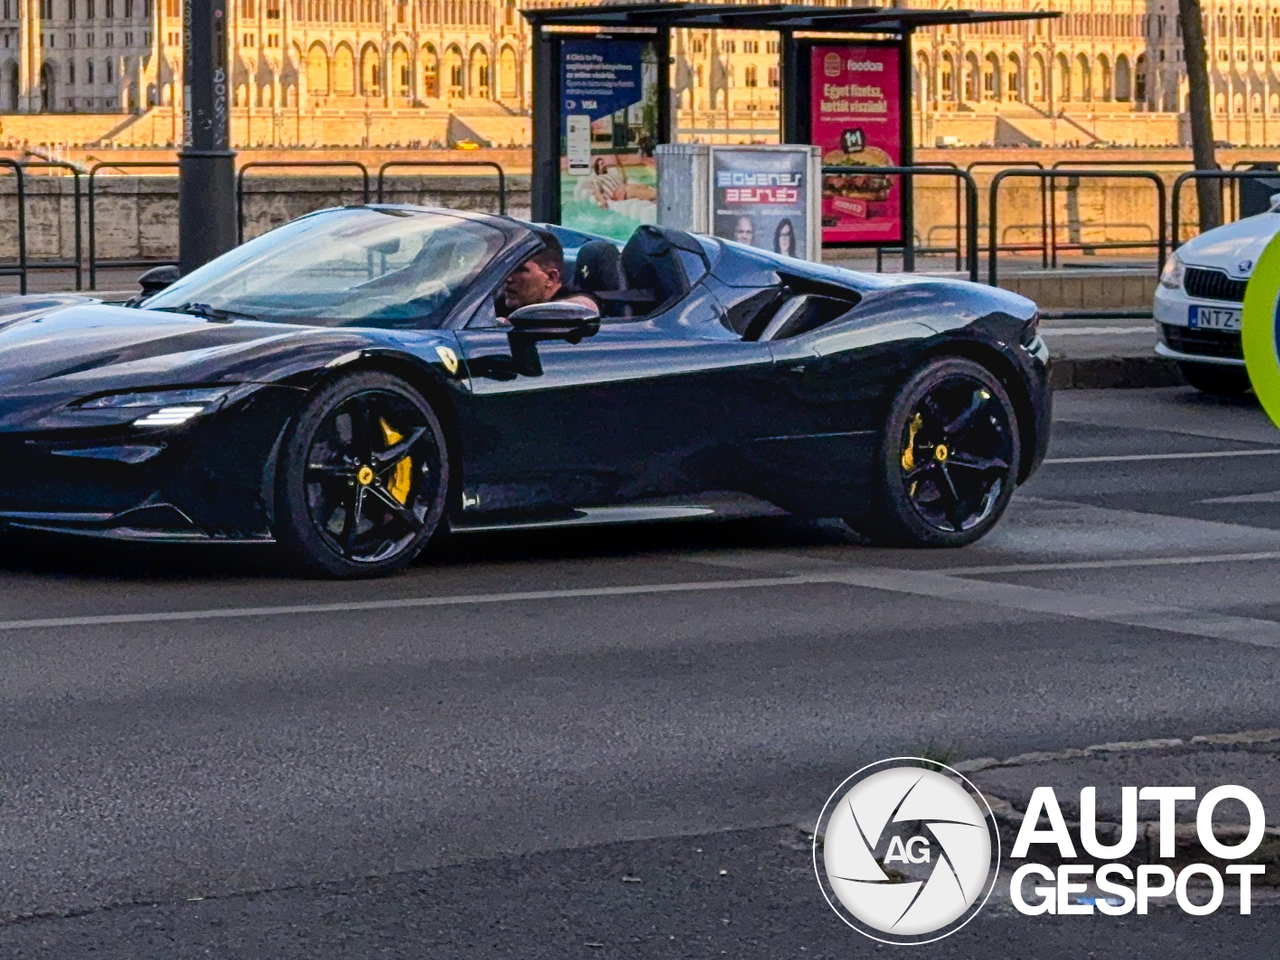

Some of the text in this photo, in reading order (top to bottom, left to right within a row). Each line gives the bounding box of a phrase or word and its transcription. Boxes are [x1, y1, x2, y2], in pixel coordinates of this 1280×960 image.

[592, 54, 604, 63] Pay
[847, 59, 884, 72] foodora
[824, 84, 884, 100] Egyet fizetsz,
[581, 101, 598, 109] VISA
[718, 172, 802, 186] EGYENES
[726, 187, 798, 202] BESZÉD
